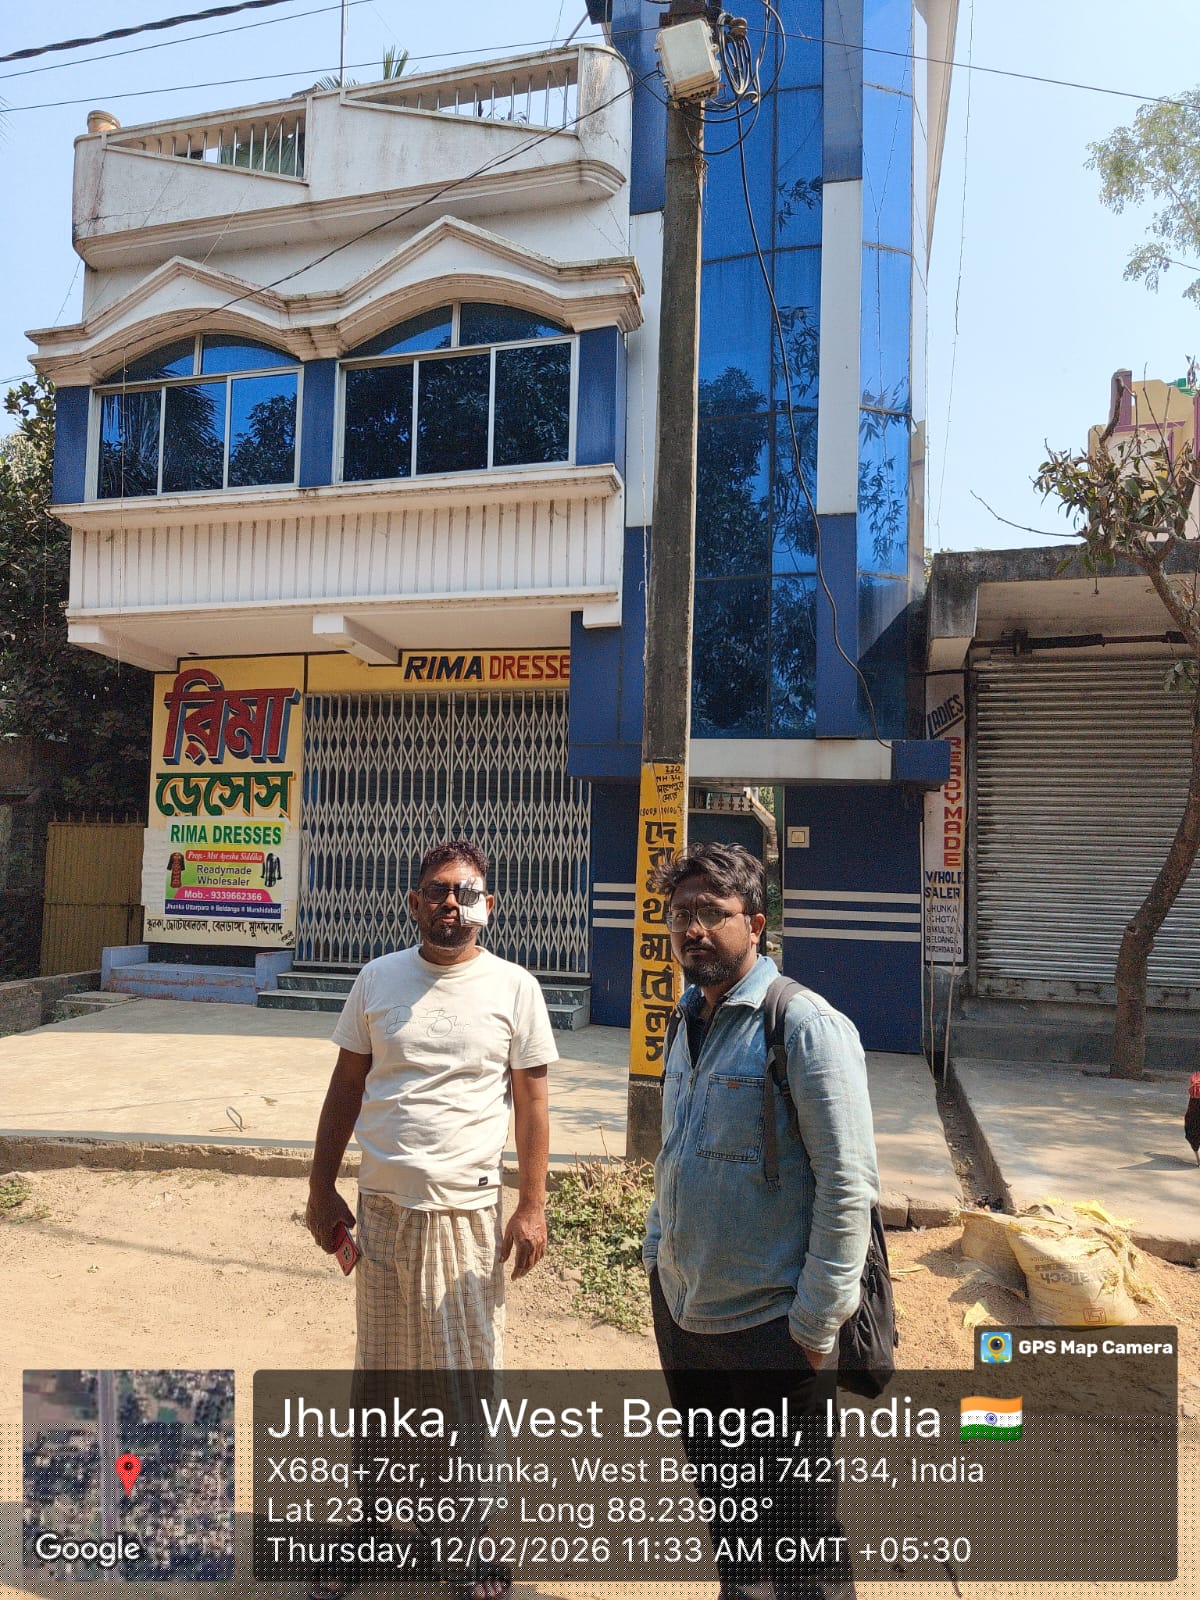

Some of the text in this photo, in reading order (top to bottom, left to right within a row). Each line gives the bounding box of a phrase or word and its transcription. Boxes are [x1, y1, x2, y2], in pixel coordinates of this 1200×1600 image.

[403, 655, 484, 681] RIMA
[163, 668, 301, 766] রিমা
[927, 694, 964, 739] LADIES
[170, 824, 282, 845] RIMA DRESSES
[197, 864, 252, 876] Readymade
[197, 875, 250, 886] Wholesaler
[211, 891, 262, 901] 9339662366
[925, 886, 960, 899] SALER
